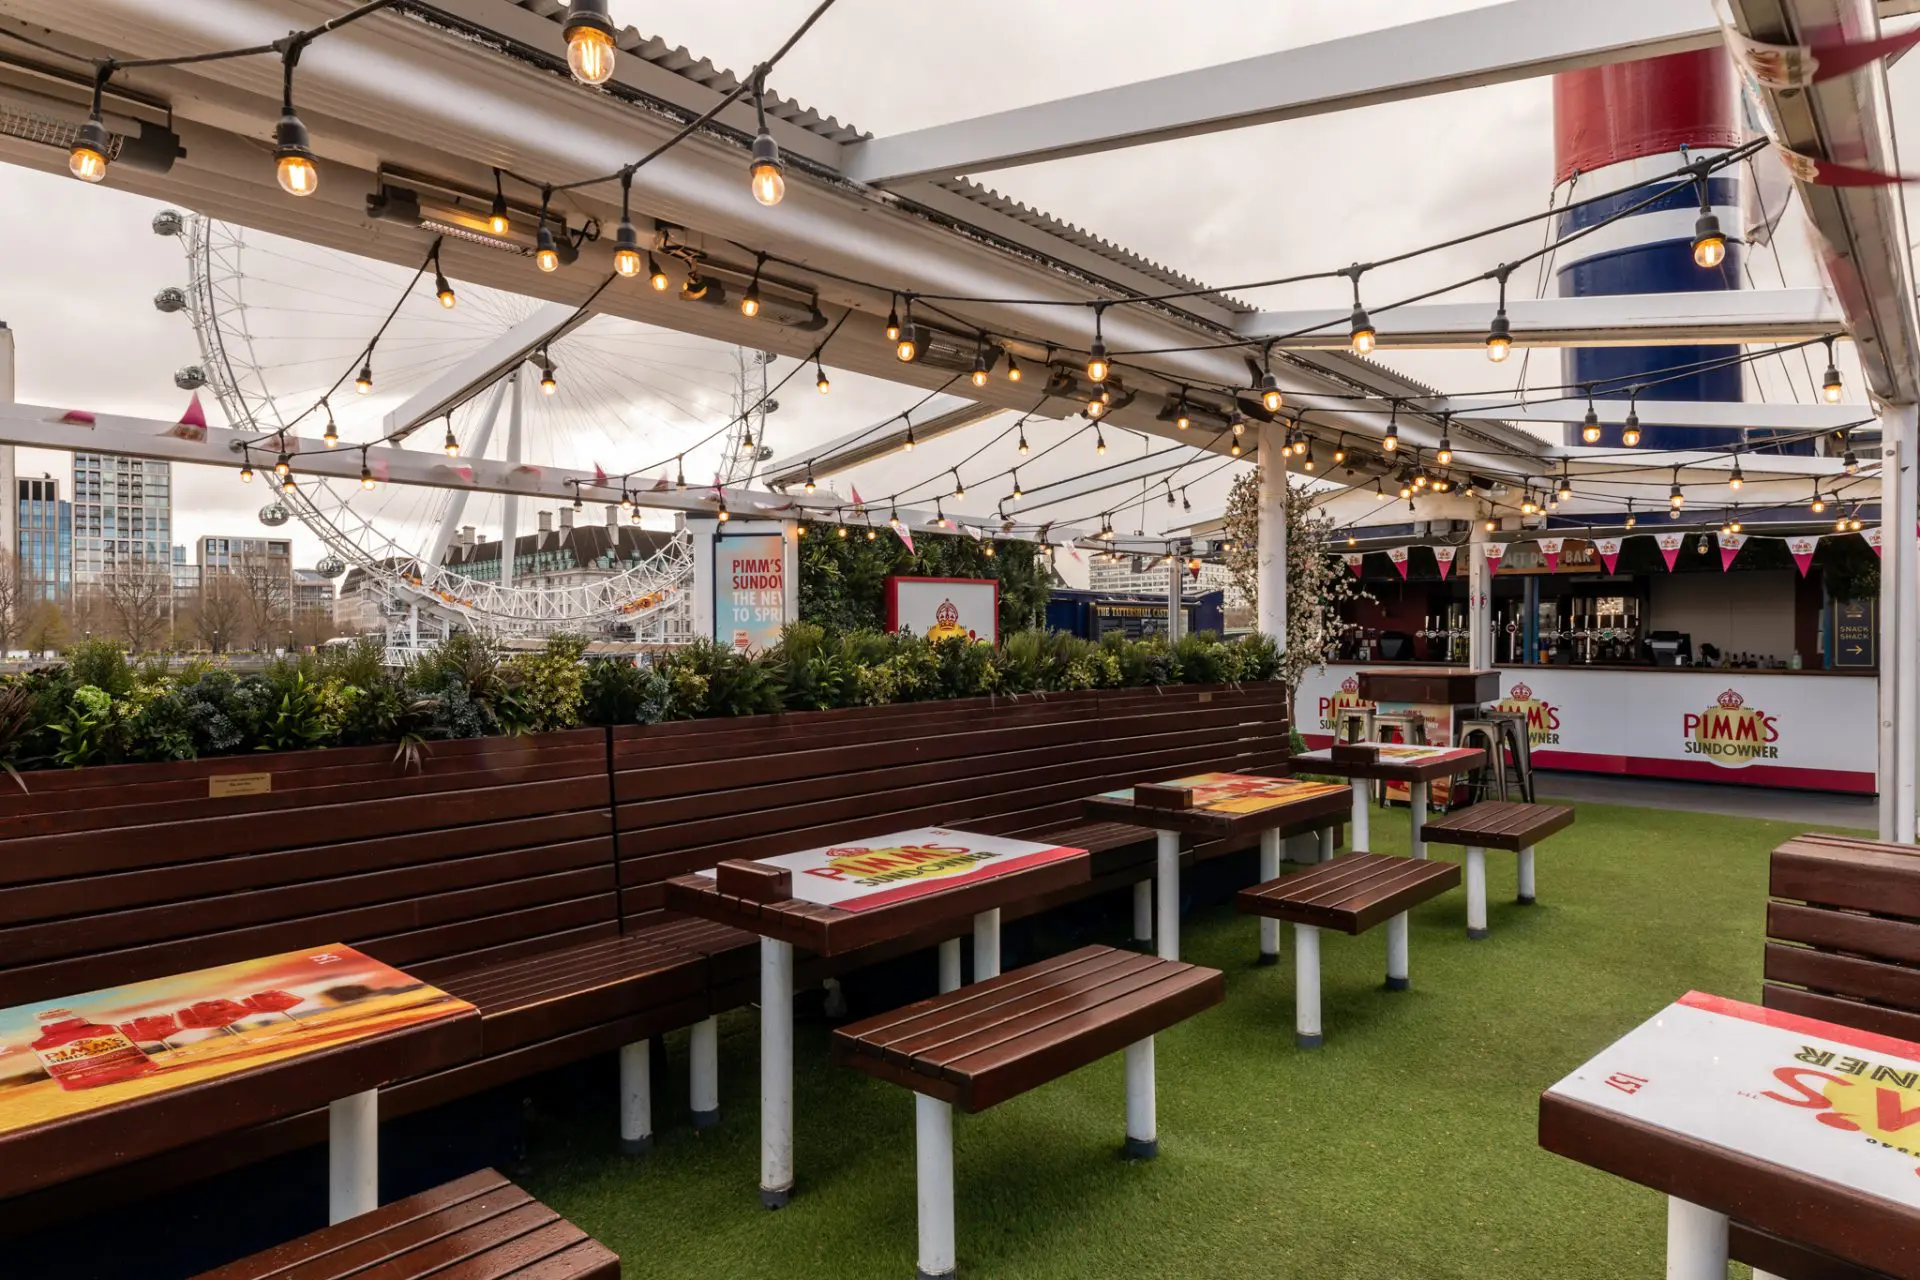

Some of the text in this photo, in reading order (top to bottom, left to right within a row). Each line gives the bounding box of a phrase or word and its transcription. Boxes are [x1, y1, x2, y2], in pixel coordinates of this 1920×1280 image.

[732, 559, 782, 573] PIMM'S
[732, 575, 782, 590] SUNDO
[732, 591, 756, 606] THE
[732, 607, 750, 622] TO
[1097, 606, 1110, 617] THE
[1153, 608, 1169, 618] CAST
[1683, 711, 1779, 743] PIMM'S
[1684, 741, 1779, 759] SUNDOWNER
[802, 843, 971, 882] PIMM'S
[853, 851, 1003, 887] SUNDOWNER
[44, 1037, 124, 1061] PIMM'S
